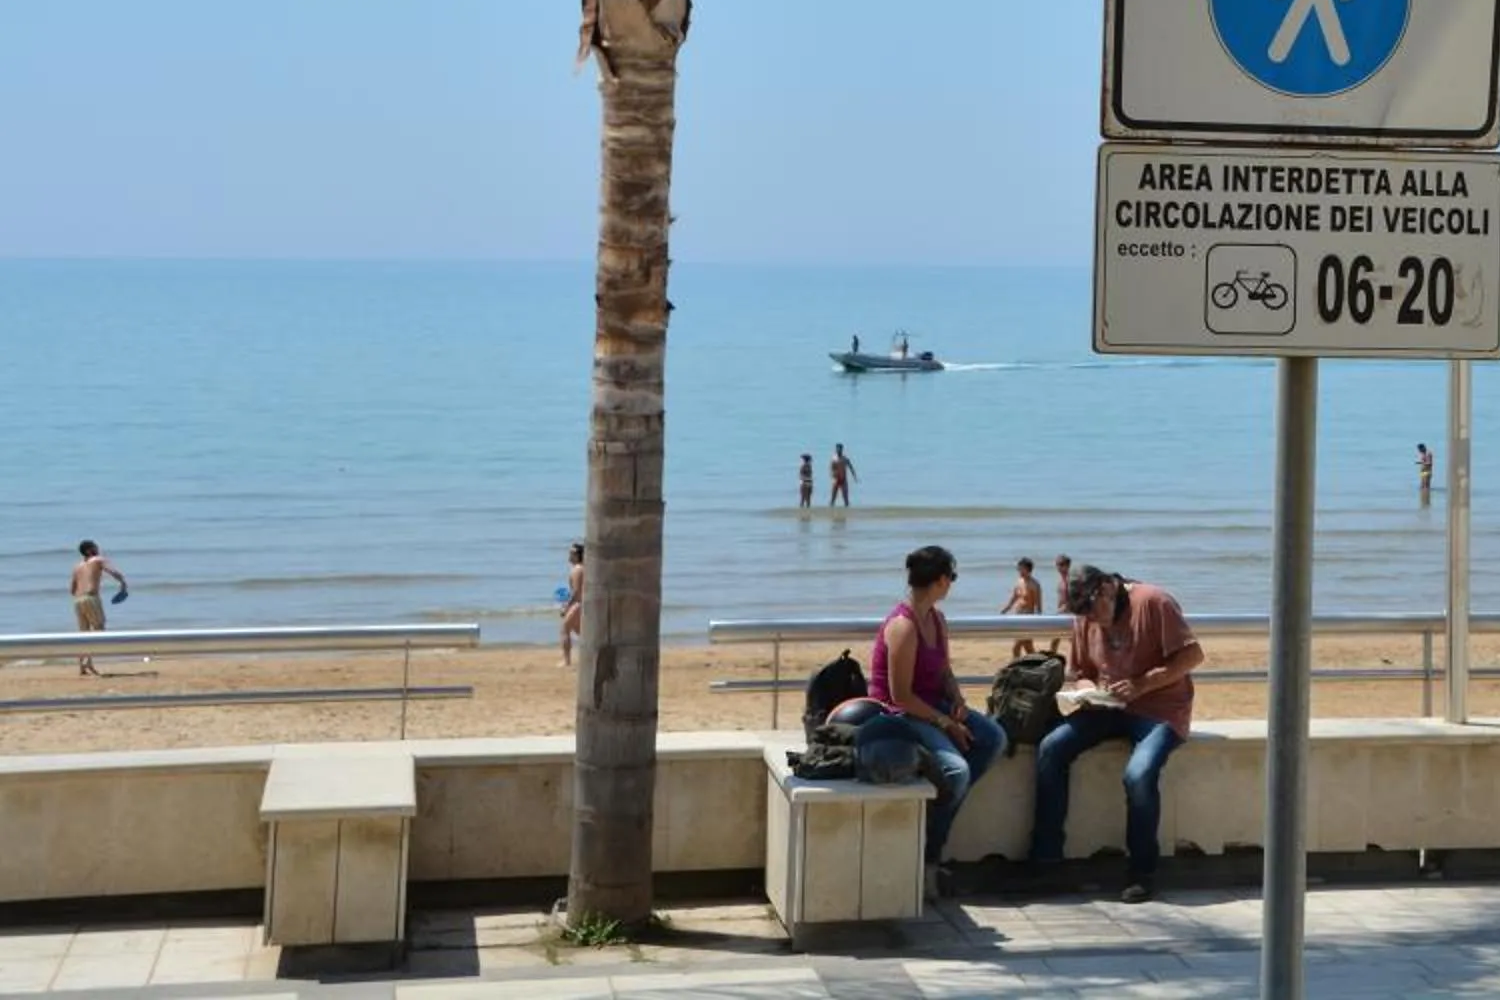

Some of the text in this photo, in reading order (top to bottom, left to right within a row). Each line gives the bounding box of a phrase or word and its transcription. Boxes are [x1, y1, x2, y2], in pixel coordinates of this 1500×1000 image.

[1137, 162, 1469, 199] AREA INTERDETTA ALLA
[1115, 199, 1490, 236] CIRCOLAZIONE DEI VEICOLI
[1317, 254, 1455, 326] 06-20
